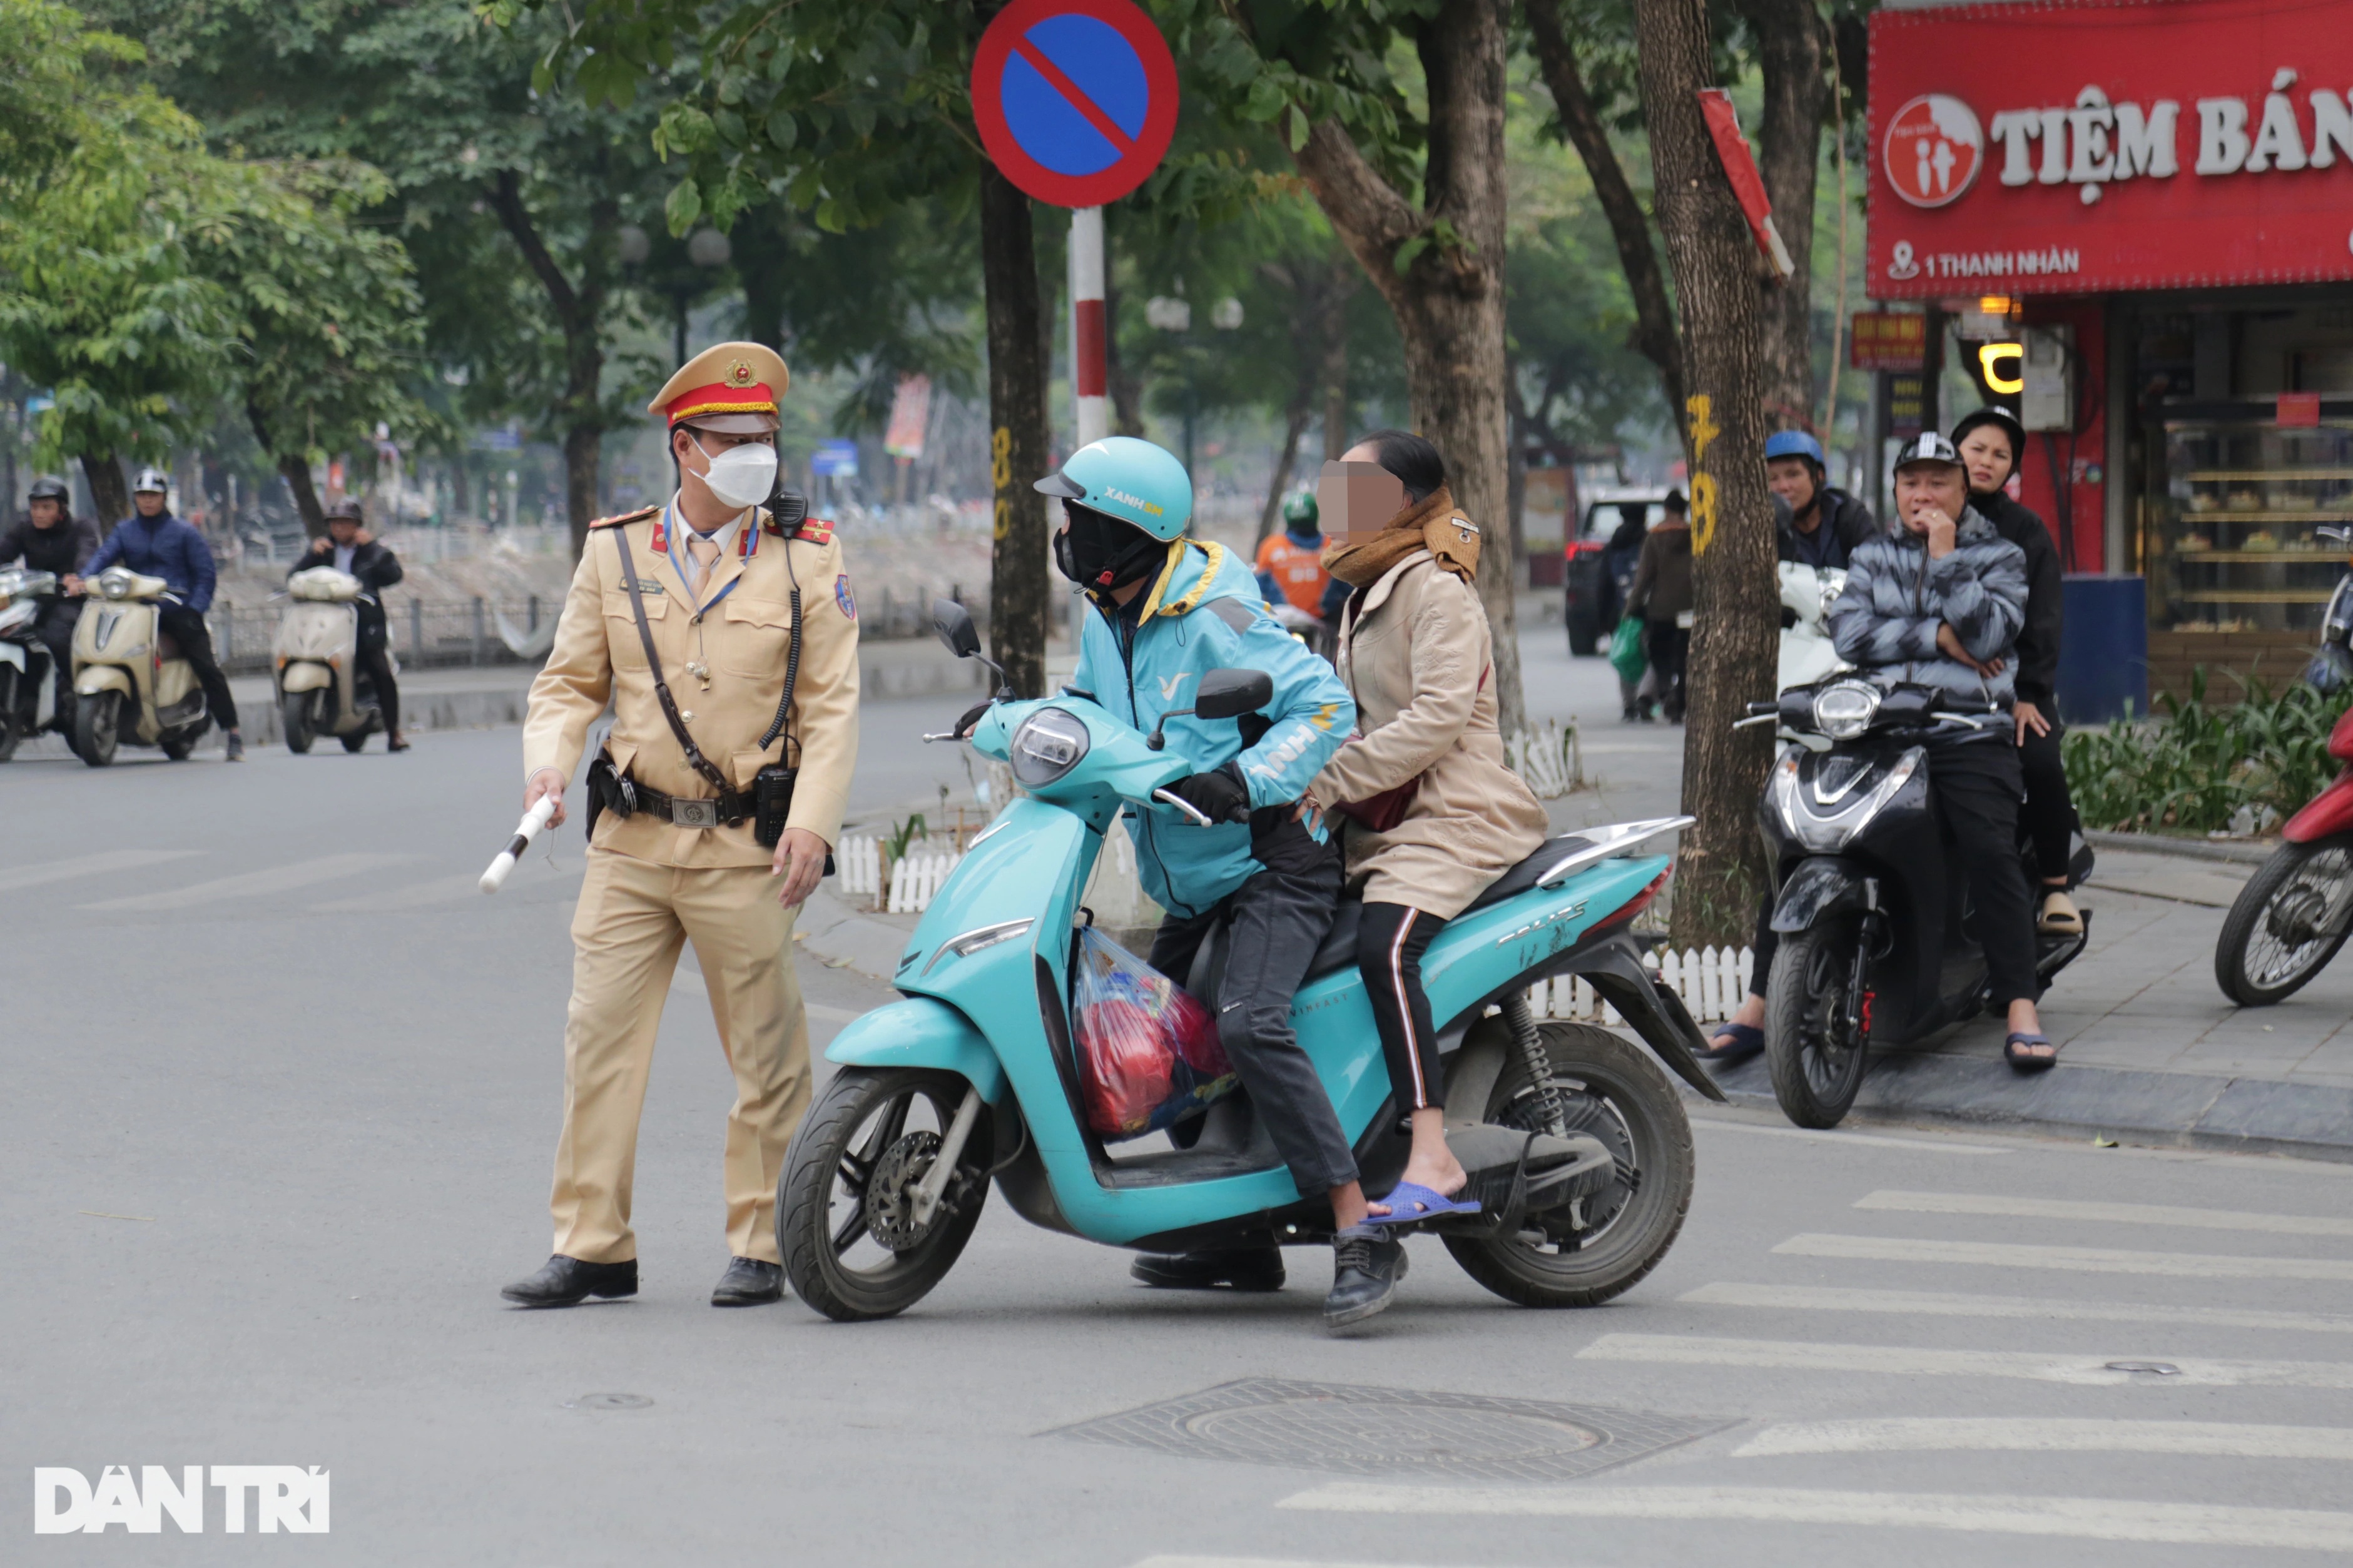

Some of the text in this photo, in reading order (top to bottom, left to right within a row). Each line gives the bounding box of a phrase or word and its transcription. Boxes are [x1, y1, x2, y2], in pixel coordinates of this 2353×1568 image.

[1991, 84, 2181, 205] TIỆM
[1926, 244, 2079, 278] 1 THANH NHÀN
[1290, 993, 1348, 1018] VINFAST
